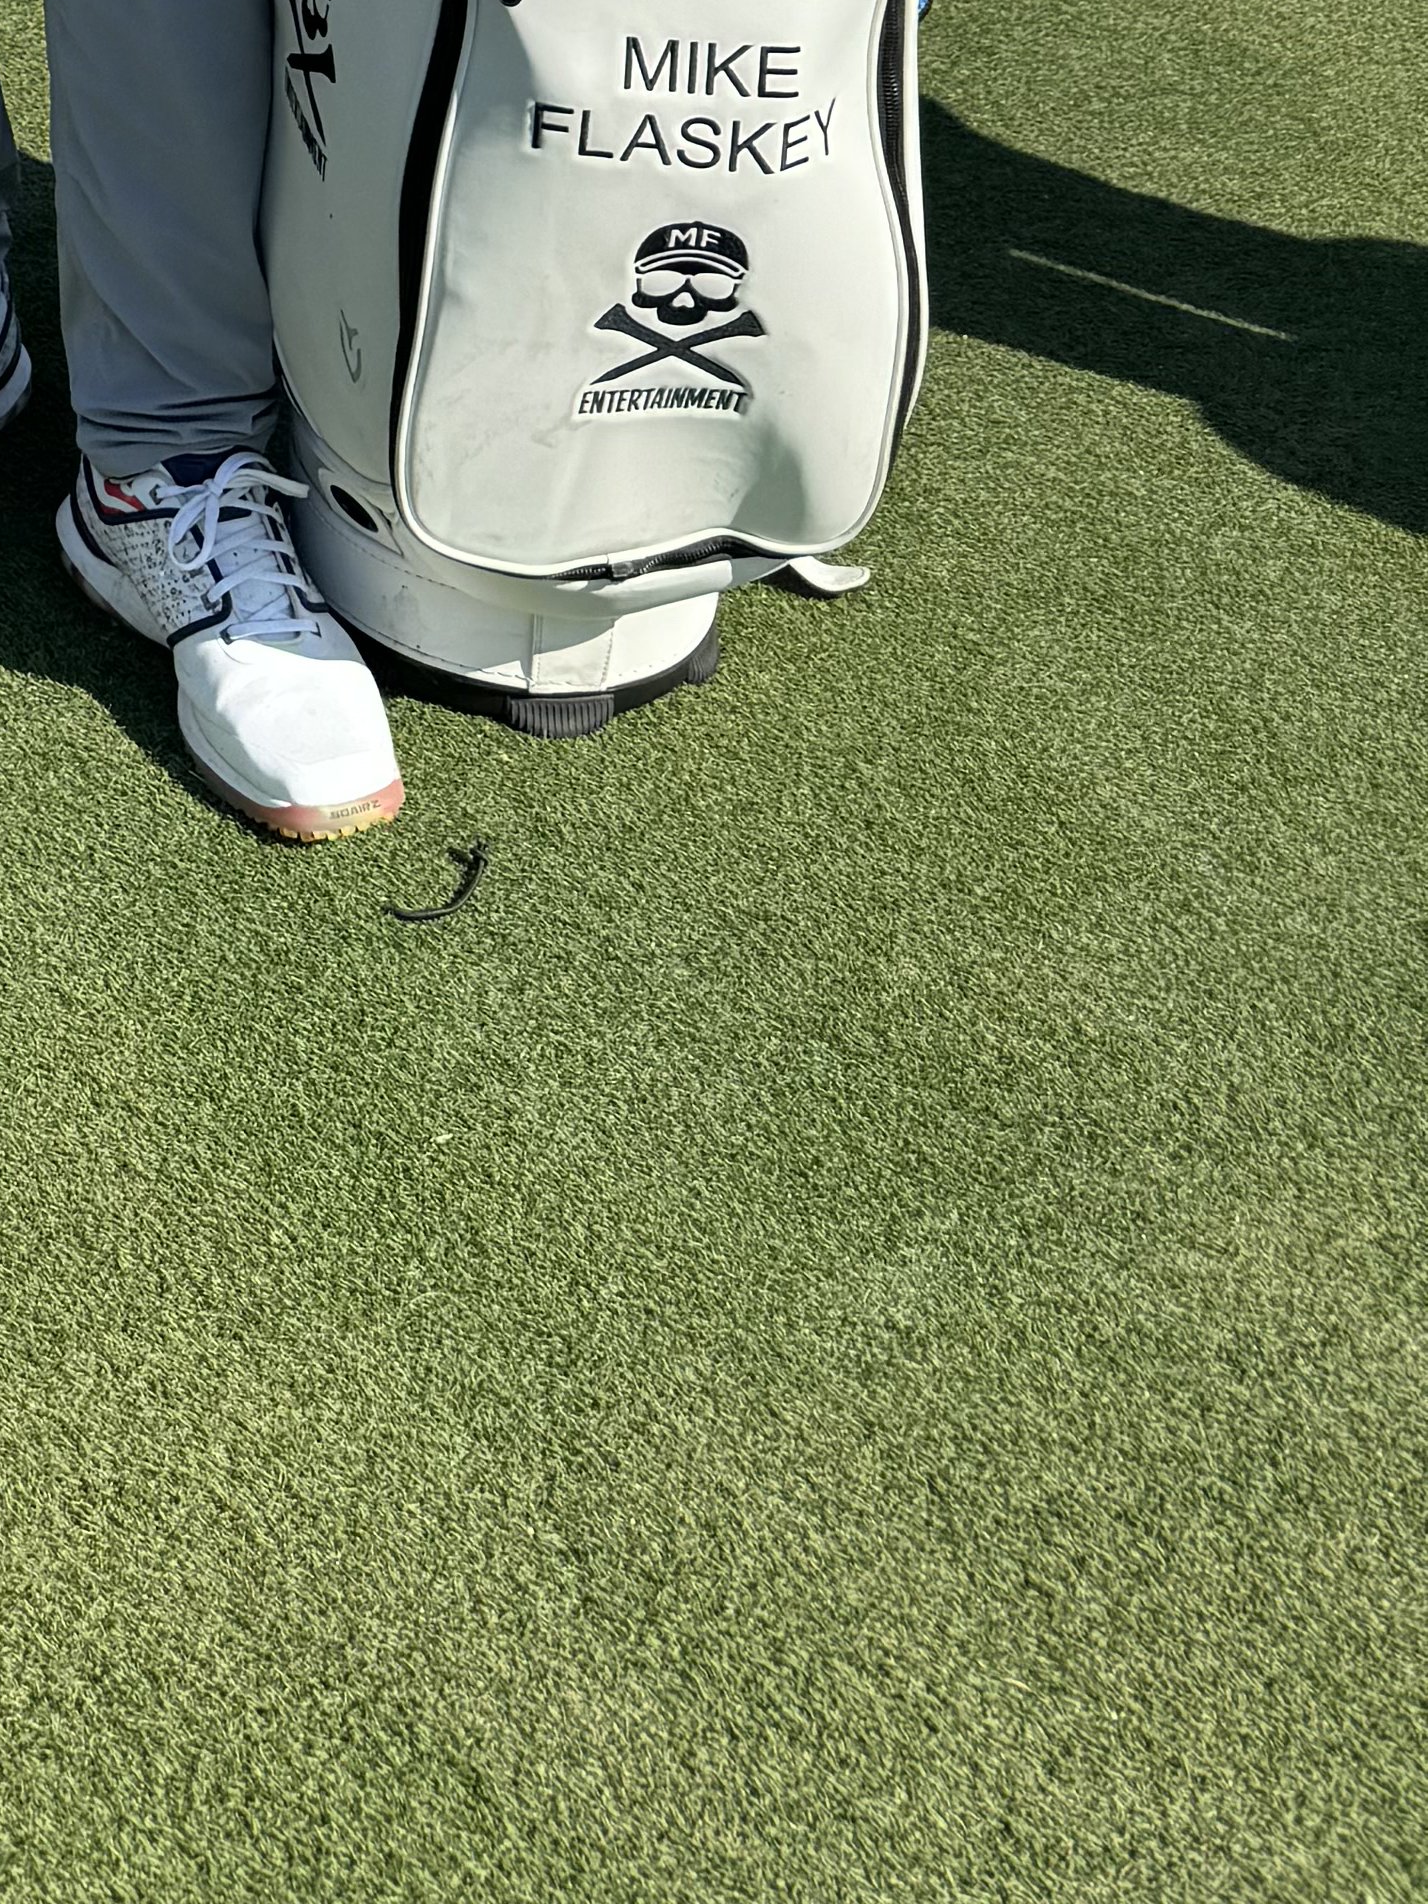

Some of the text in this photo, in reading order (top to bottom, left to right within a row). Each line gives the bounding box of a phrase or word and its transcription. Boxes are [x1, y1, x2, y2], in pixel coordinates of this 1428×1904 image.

[623, 35, 801, 99] MIKE
[530, 96, 837, 175] FLASKEY
[667, 227, 721, 248] MF
[578, 387, 749, 415] ENTERTAINMENT
